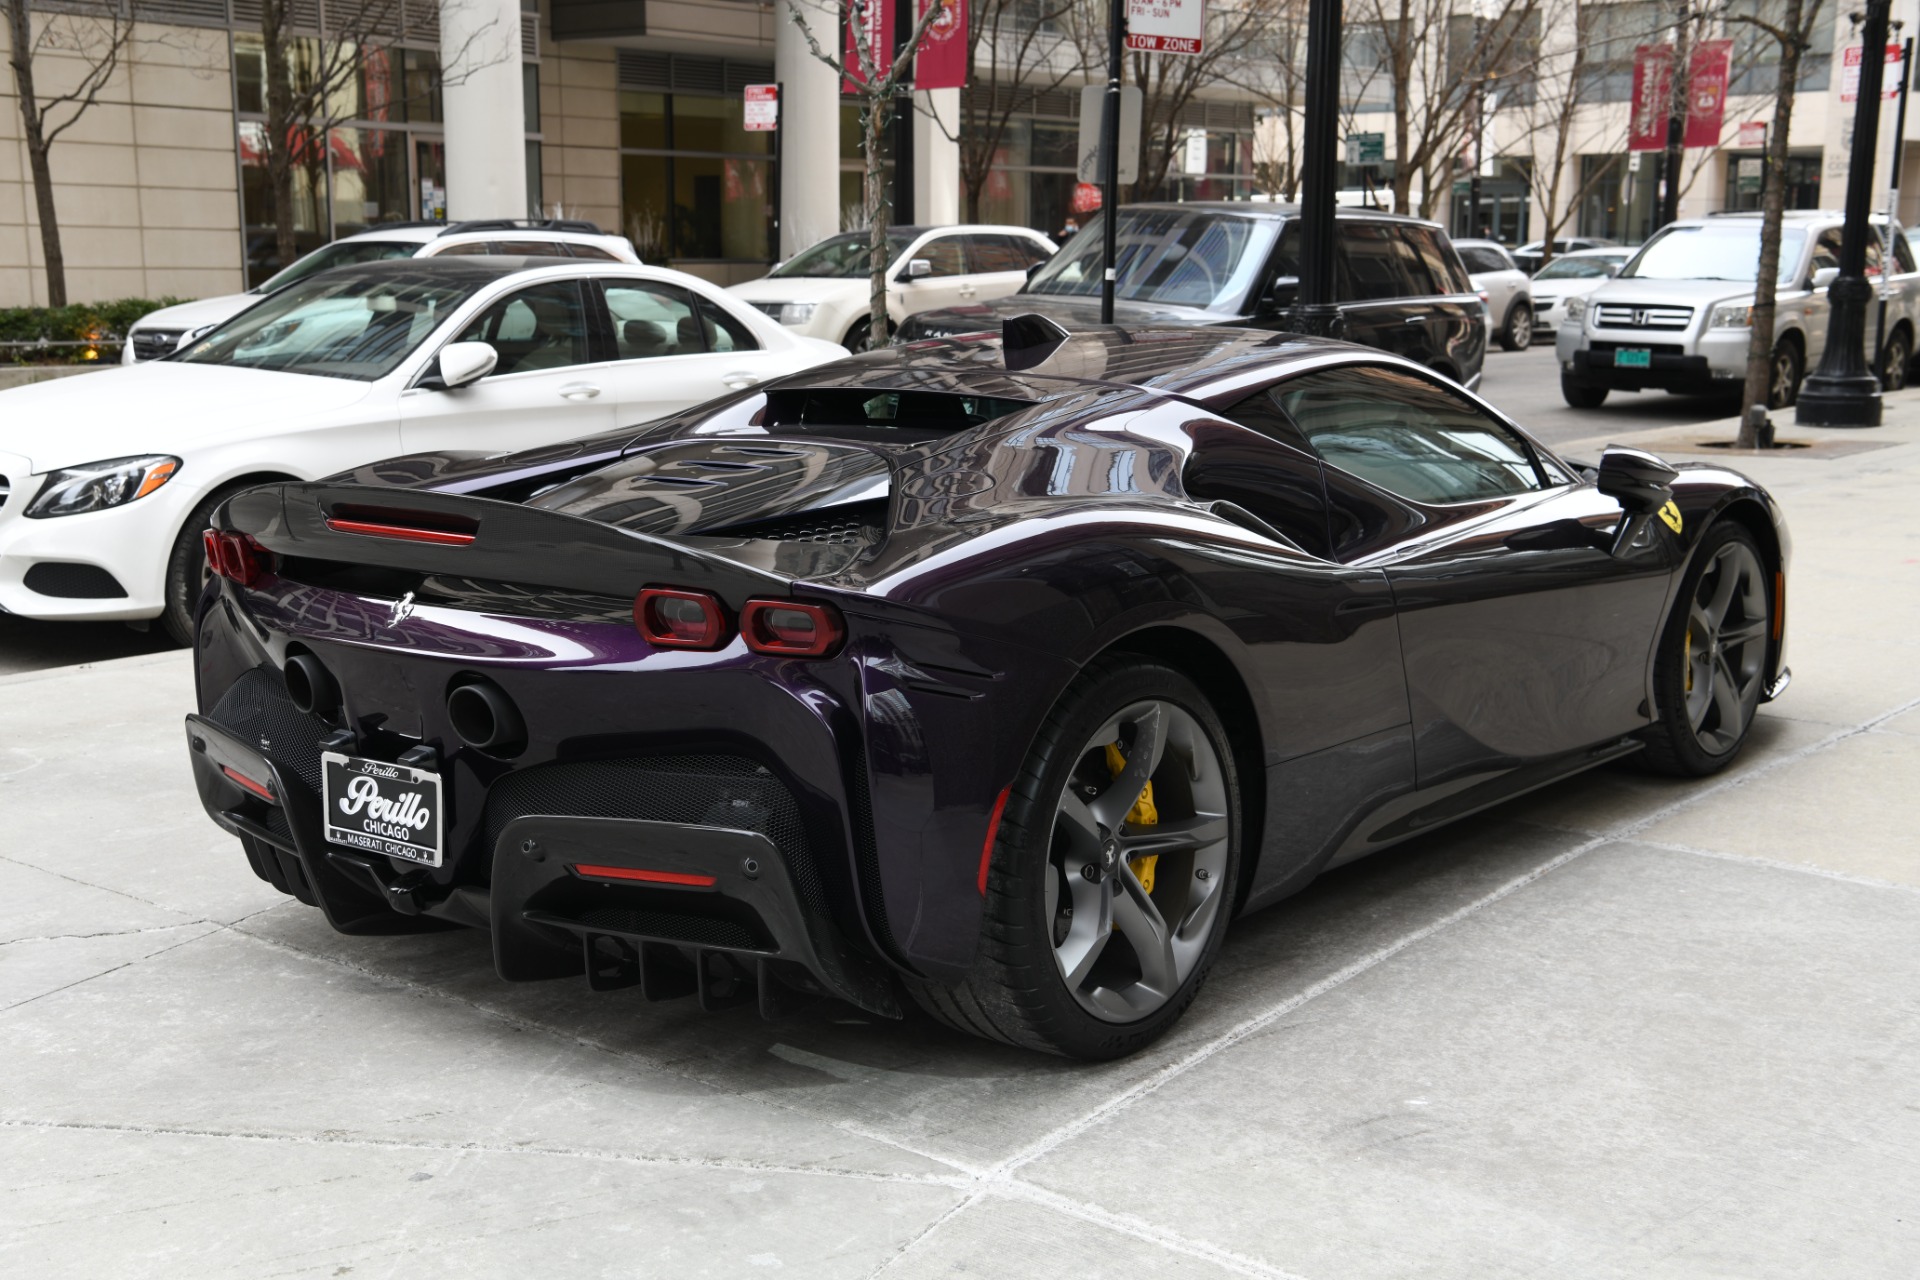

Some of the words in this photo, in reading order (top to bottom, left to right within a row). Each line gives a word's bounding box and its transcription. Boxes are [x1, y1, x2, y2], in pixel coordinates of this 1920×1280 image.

[1131, 6, 1145, 16] FRI
[1153, 7, 1170, 18] SUN
[874, 34, 882, 70] WATER
[1130, 35, 1157, 48] TOW
[1163, 38, 1196, 52] ZONE
[362, 762, 399, 778] Perillo
[339, 776, 430, 830] Perillo
[363, 819, 410, 841] CHICAGO
[347, 833, 382, 850] MASERATI
[385, 843, 417, 859] CHICAGO
